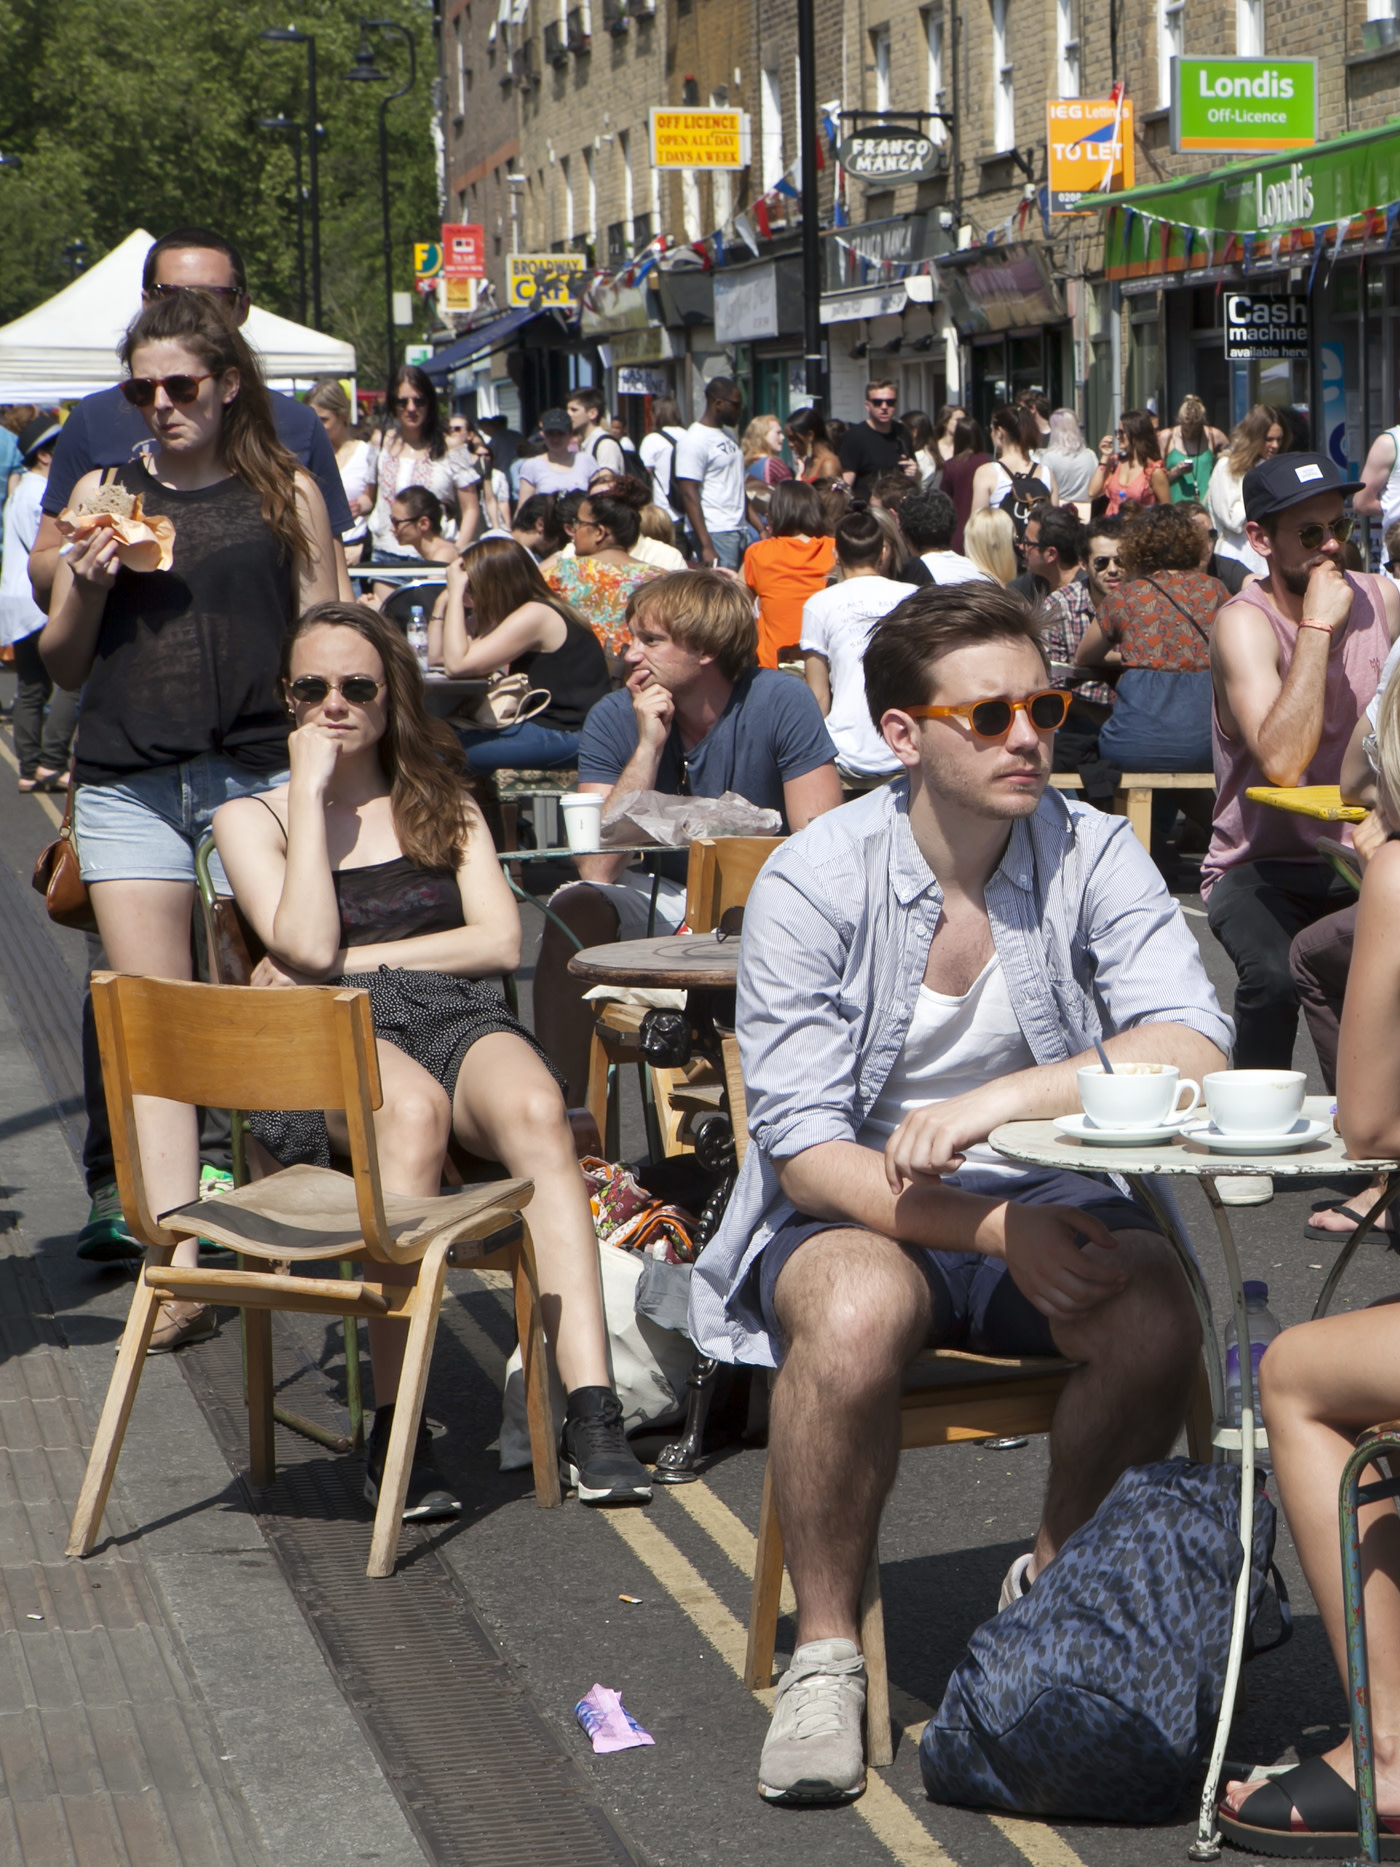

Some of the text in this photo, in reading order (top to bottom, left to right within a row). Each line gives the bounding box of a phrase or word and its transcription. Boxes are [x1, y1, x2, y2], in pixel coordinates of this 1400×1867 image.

[1199, 69, 1295, 99] Londis
[1050, 105, 1082, 119] IEG
[1207, 108, 1287, 124] Off-Licence
[657, 116, 737, 129] OFF LICENCE
[659, 135, 734, 146] OPEN ALL DAY
[852, 138, 928, 157] FRANCO
[665, 151, 693, 162] DAYS
[696, 152, 702, 162] A
[705, 151, 737, 163] WEEK
[1052, 142, 1124, 161] TO LET
[856, 154, 924, 172] MANCA
[1256, 162, 1314, 228] Londis
[513, 261, 579, 275] BROADWAY
[1229, 295, 1307, 324] Cash
[1229, 324, 1307, 341] machine
[1230, 346, 1308, 358] available here
